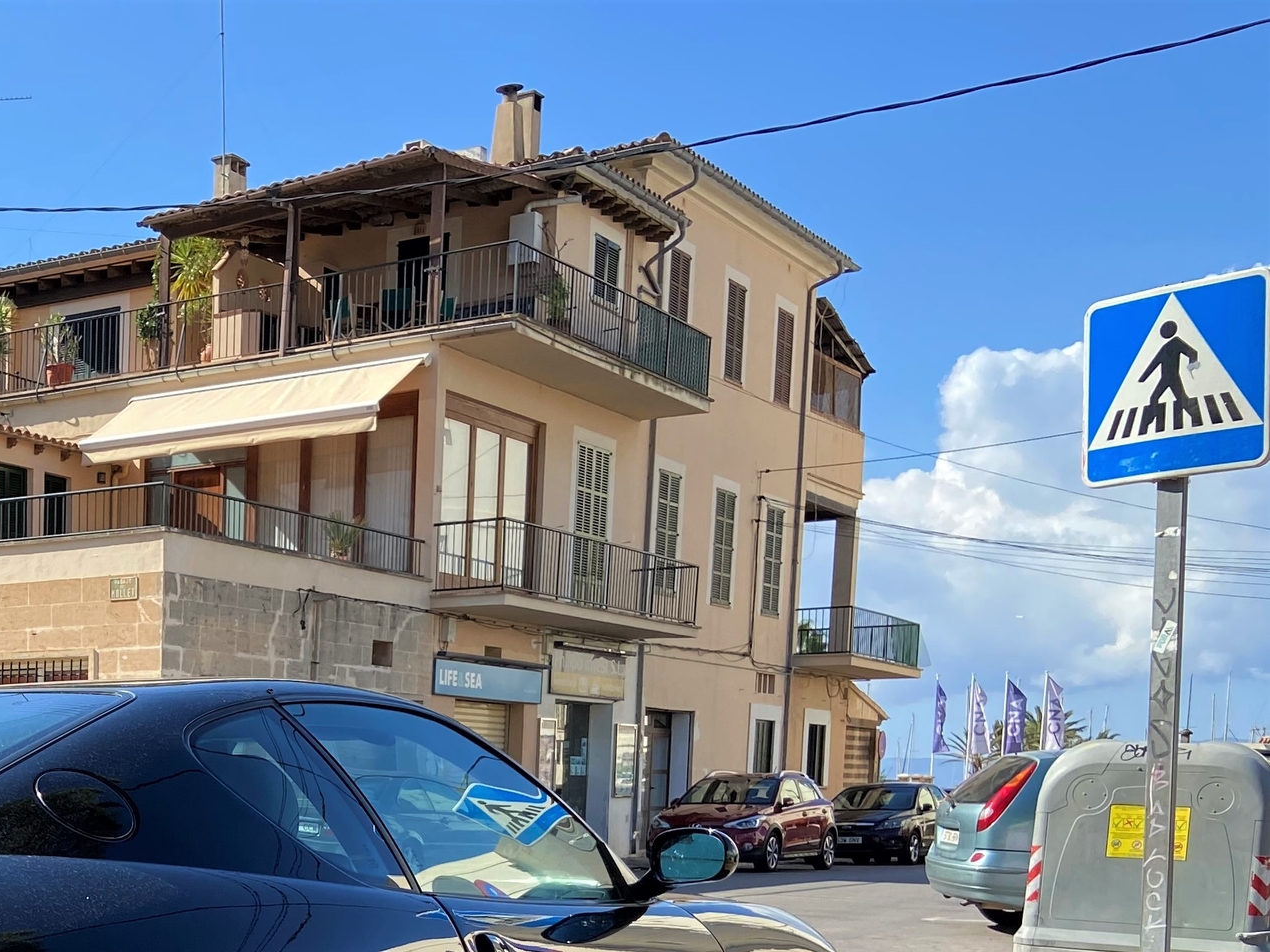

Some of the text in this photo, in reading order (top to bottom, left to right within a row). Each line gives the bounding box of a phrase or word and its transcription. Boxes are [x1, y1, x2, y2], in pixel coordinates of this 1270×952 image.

[439, 668, 458, 687] LIFE
[465, 671, 482, 690] SEA
[1007, 698, 1024, 737] CNA
[1048, 697, 1061, 735] CNA
